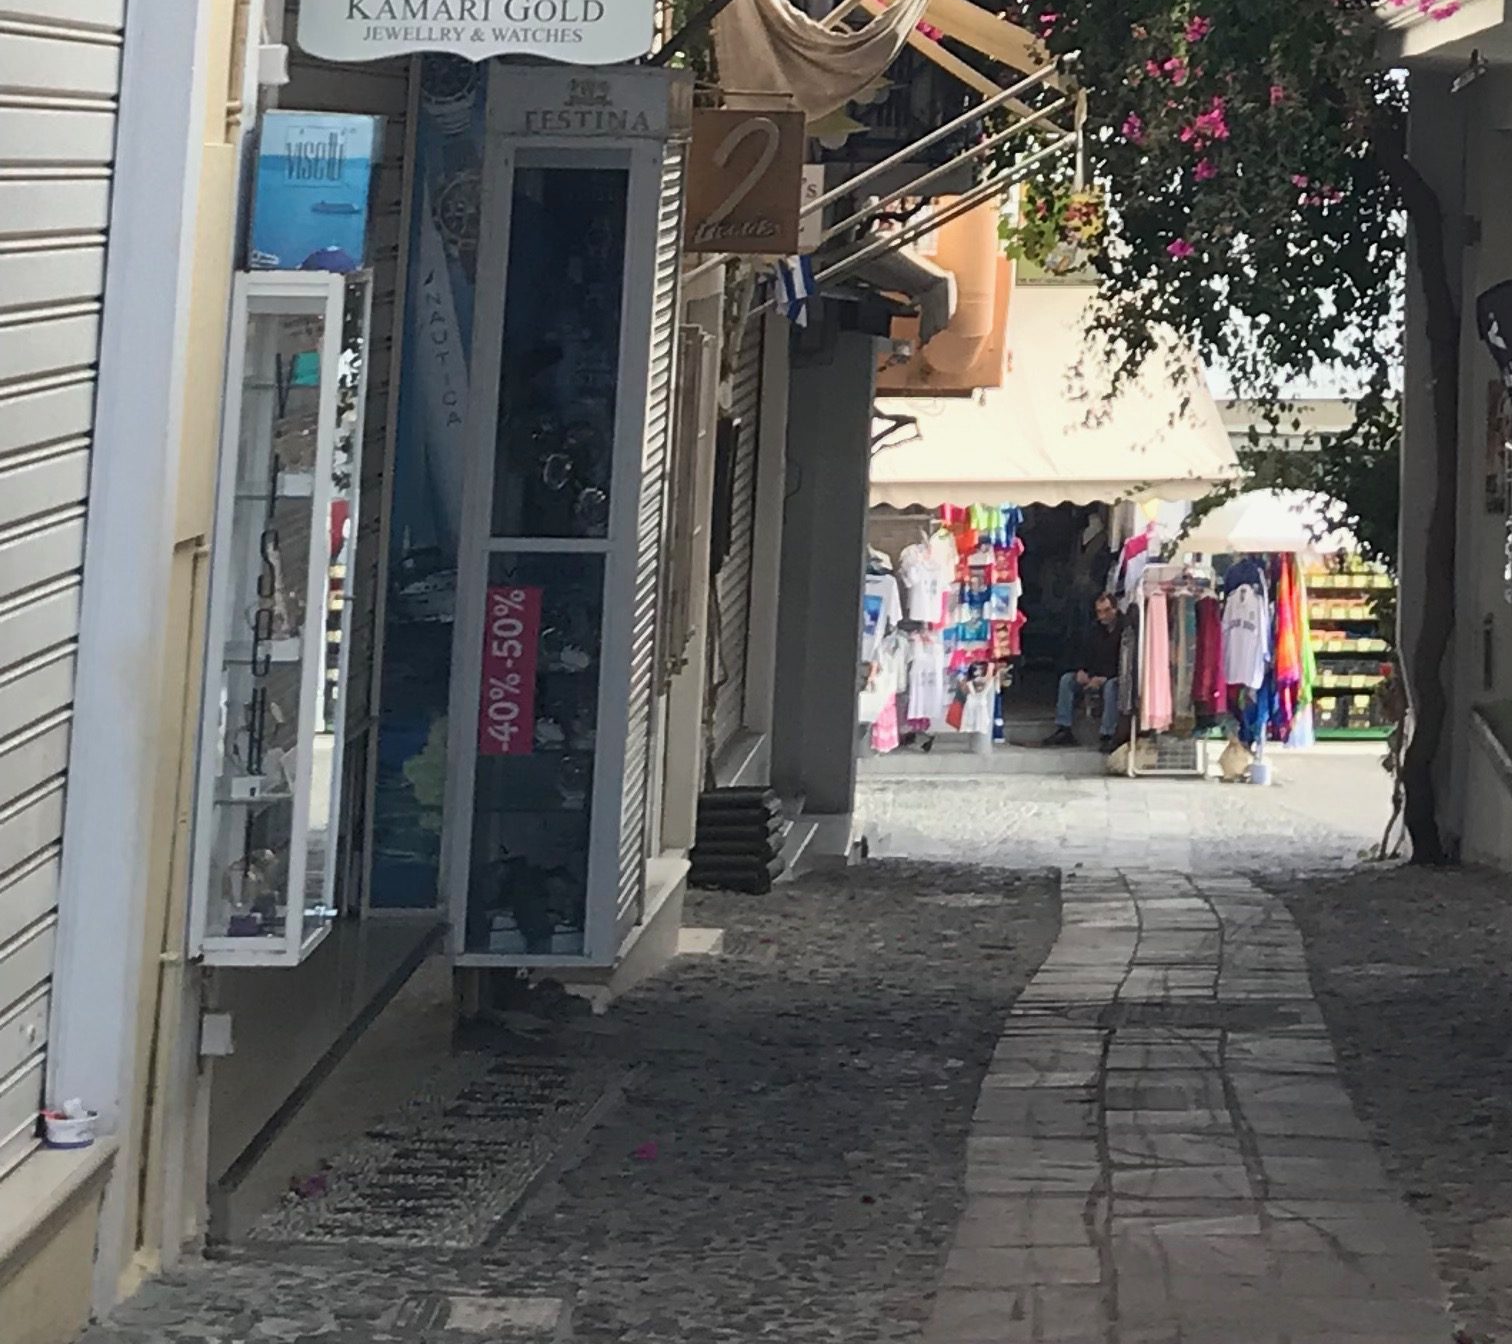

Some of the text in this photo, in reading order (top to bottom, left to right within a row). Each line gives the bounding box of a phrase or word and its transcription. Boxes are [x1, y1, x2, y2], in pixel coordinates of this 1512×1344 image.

[363, 25, 584, 44] JEWELLRY & WATCHES
[524, 110, 651, 132] FESTINA
